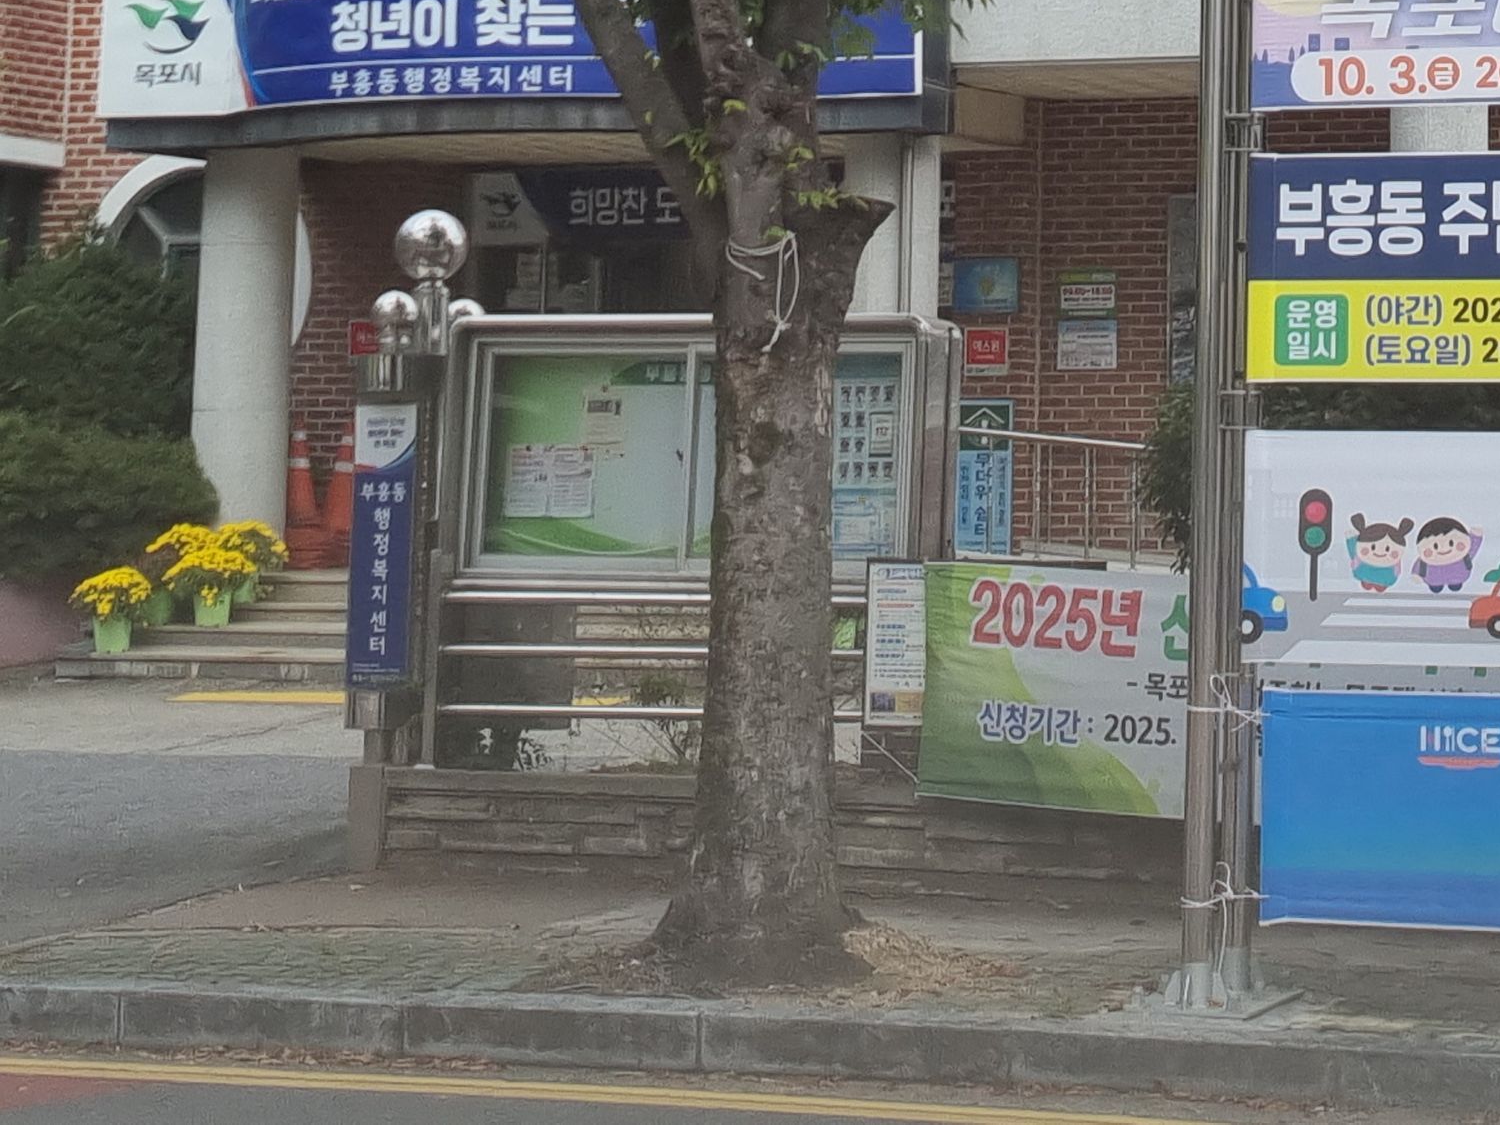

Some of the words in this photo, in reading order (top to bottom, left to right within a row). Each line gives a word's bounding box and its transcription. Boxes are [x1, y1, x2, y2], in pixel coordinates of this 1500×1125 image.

[134, 62, 202, 88] 목포시
[328, 64, 574, 97] 부흥동행정복지센터
[1318, 56, 1375, 97] 10.
[568, 186, 648, 225] 희망찬
[1276, 179, 1426, 257] 부흥동
[1287, 299, 1338, 330] 운영
[1365, 294, 1443, 327] (야간)
[1287, 332, 1337, 362] 일시
[1365, 334, 1471, 367] (토요일)
[360, 481, 406, 503] 부흥동
[369, 507, 391, 656] 행정복지센터
[970, 579, 1143, 659] 2025년
[979, 701, 1081, 745] 신청기간
[1104, 713, 1177, 746] 2025.
